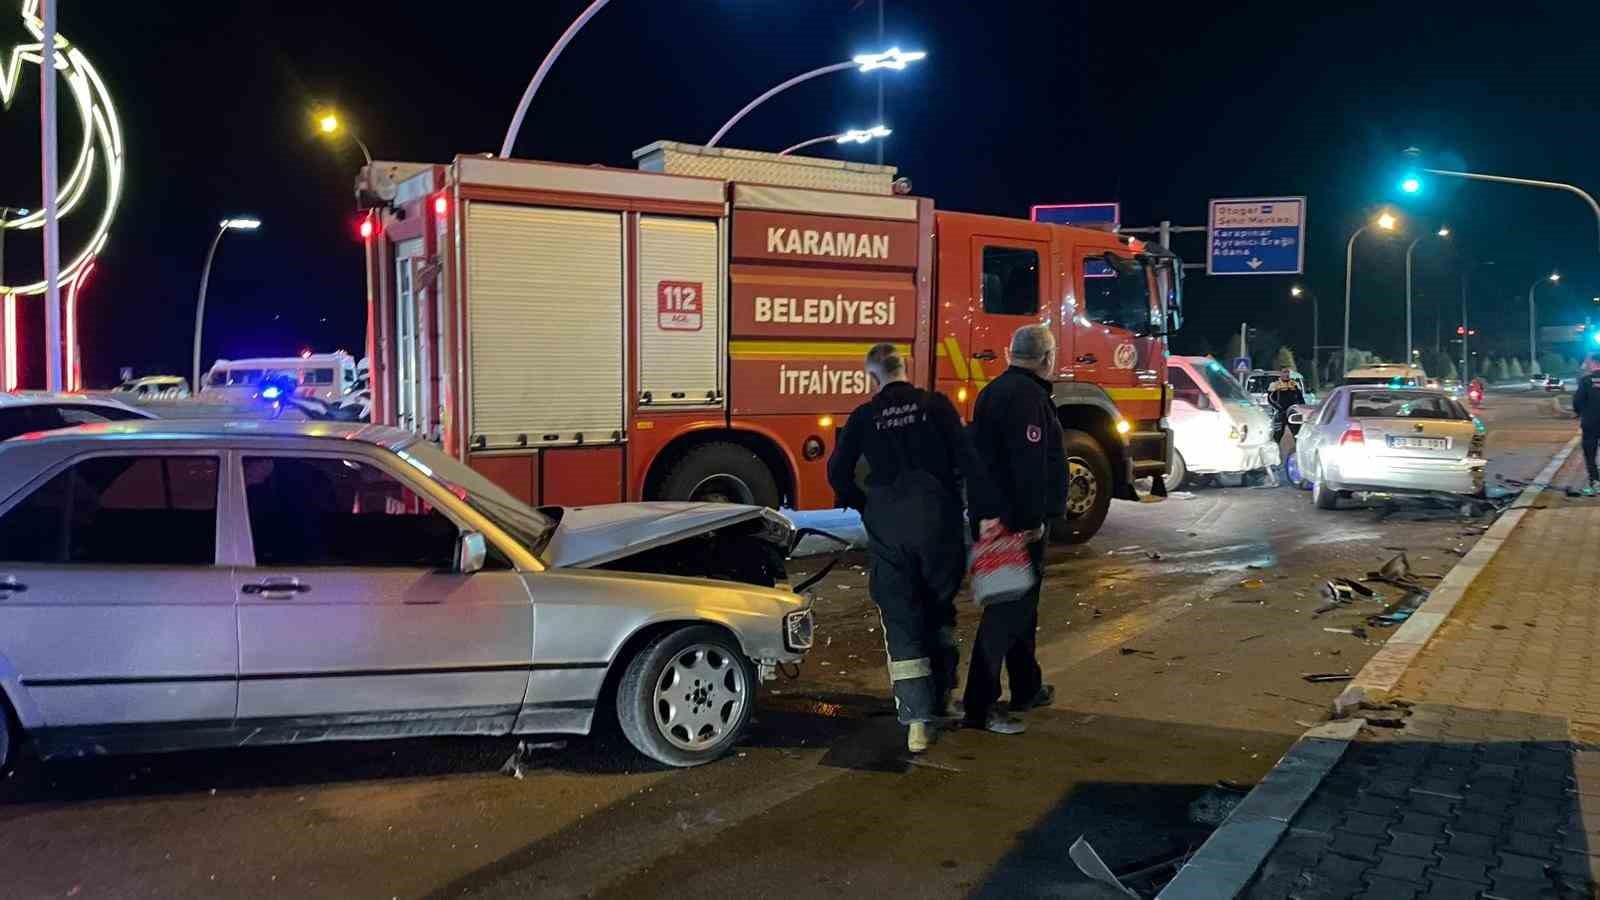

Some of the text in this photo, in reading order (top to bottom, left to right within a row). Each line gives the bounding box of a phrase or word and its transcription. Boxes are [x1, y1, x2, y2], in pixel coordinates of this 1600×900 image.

[767, 227, 889, 259] KARAMAN
[663, 285, 697, 310] 112
[754, 293, 897, 326] BELEDİYESİ
